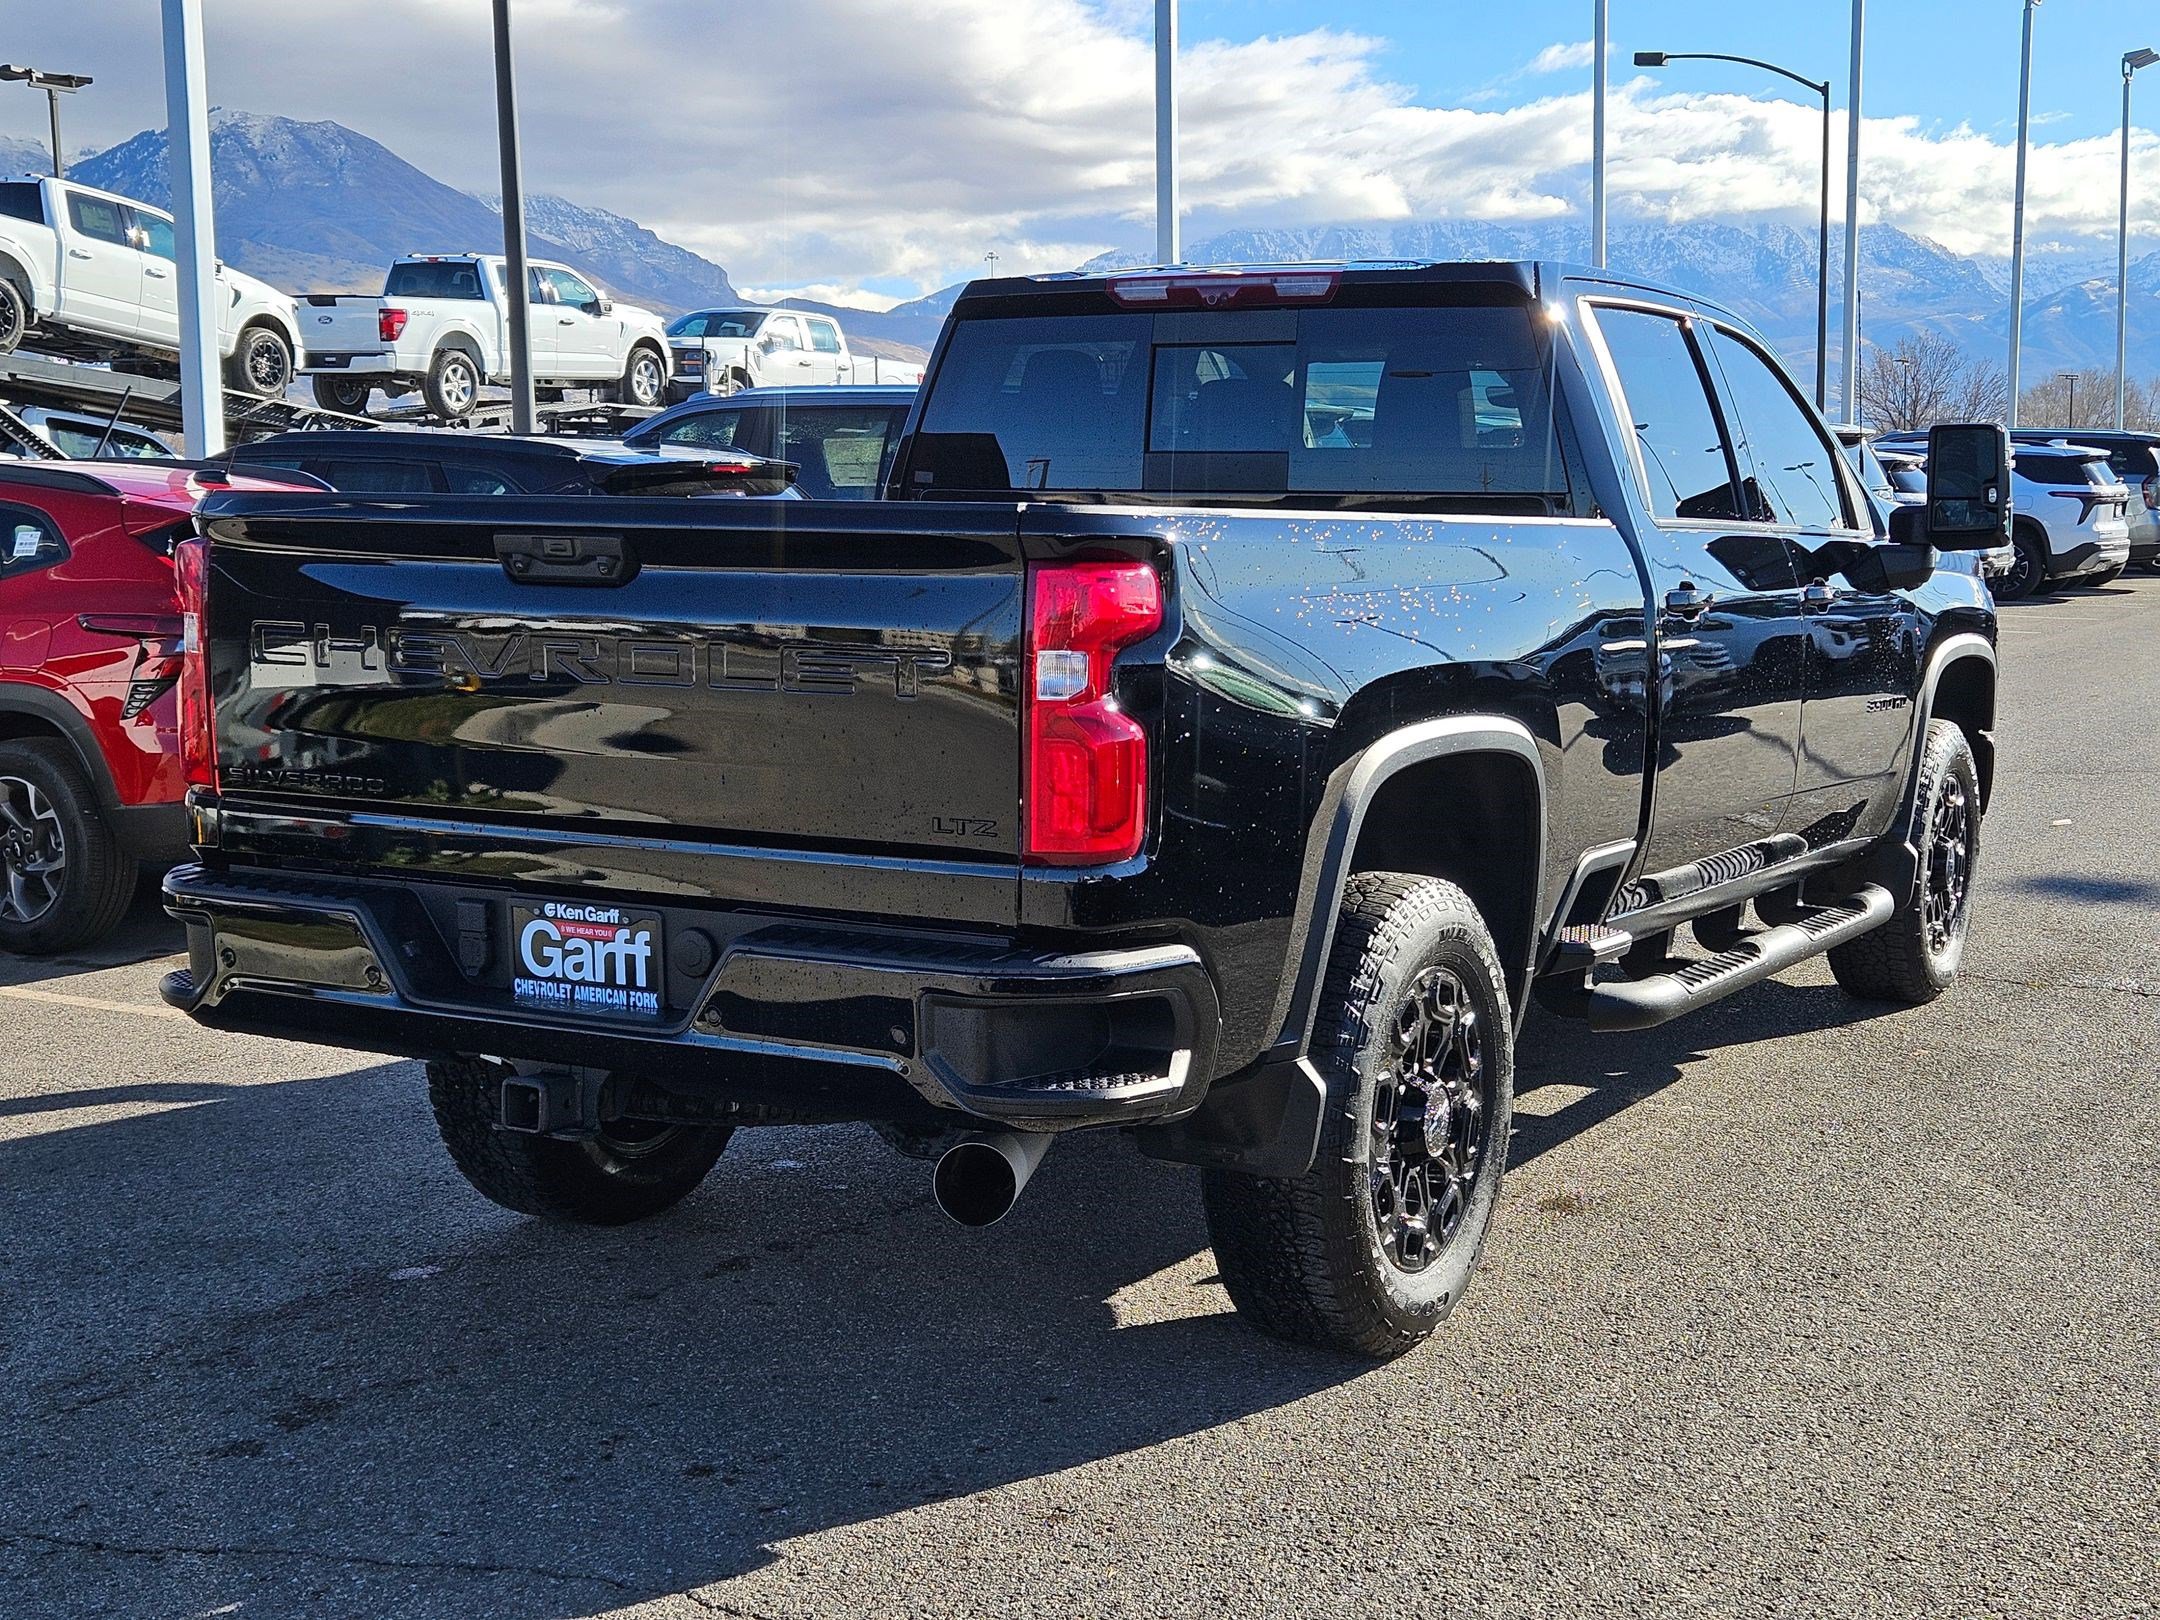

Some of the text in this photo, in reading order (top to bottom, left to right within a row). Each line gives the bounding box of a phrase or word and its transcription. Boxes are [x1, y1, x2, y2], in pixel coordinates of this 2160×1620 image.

[250, 619, 951, 701] CHEVROLET
[228, 767, 385, 793] SILVERADO
[932, 816, 998, 837] LTZ
[556, 903, 584, 921] Ken
[584, 906, 620, 924] Garff
[566, 926, 608, 937] WE HEAR YOU
[520, 919, 652, 988] Garff
[514, 977, 659, 1009] CHEVROLET AMERICAN FORK
